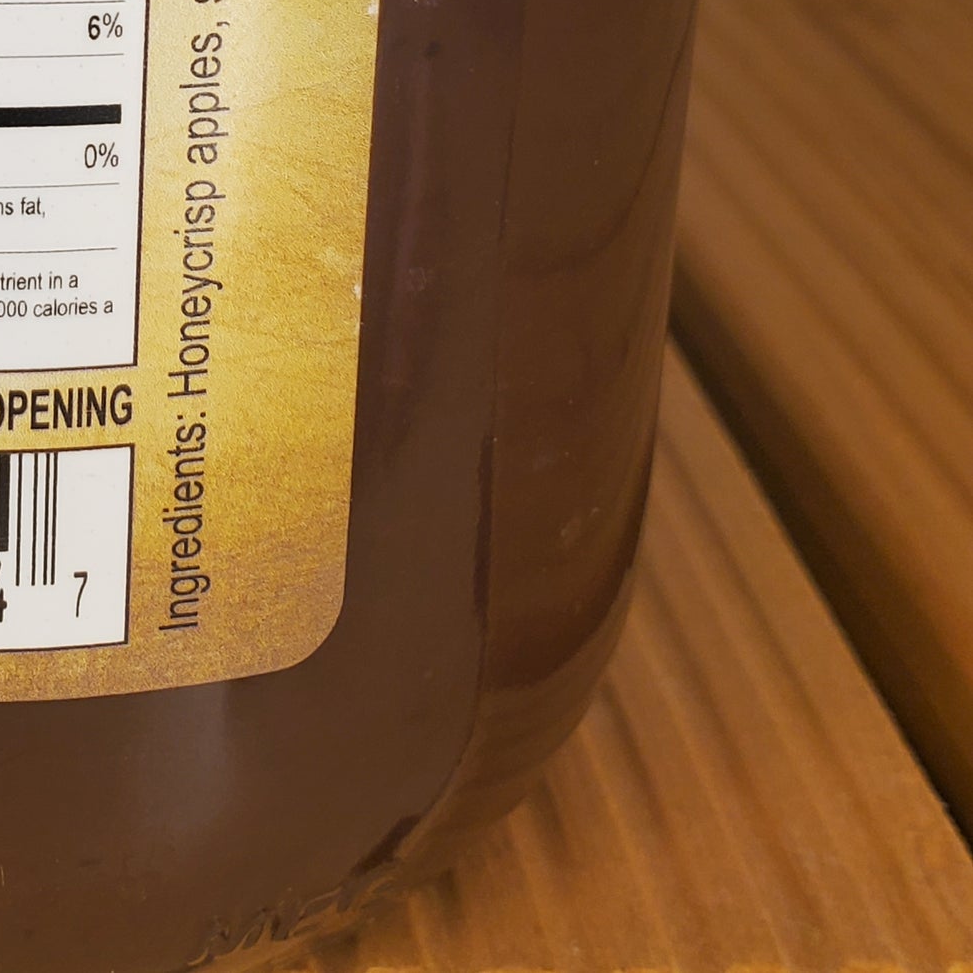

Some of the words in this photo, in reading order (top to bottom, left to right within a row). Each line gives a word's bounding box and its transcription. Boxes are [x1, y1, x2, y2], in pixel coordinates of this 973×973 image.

[88, 12, 123, 40] 6%
[179, 22, 230, 171] apples,
[85, 142, 118, 168] 0%
[21, 197, 45, 217] fat,
[49, 270, 62, 289] in
[69, 275, 78, 288] a
[167, 180, 226, 398] Honeycrisp
[33, 299, 97, 317] calories
[104, 301, 113, 313] a
[158, 412, 212, 634] Ingredients:
[74, 571, 88, 617] 7
